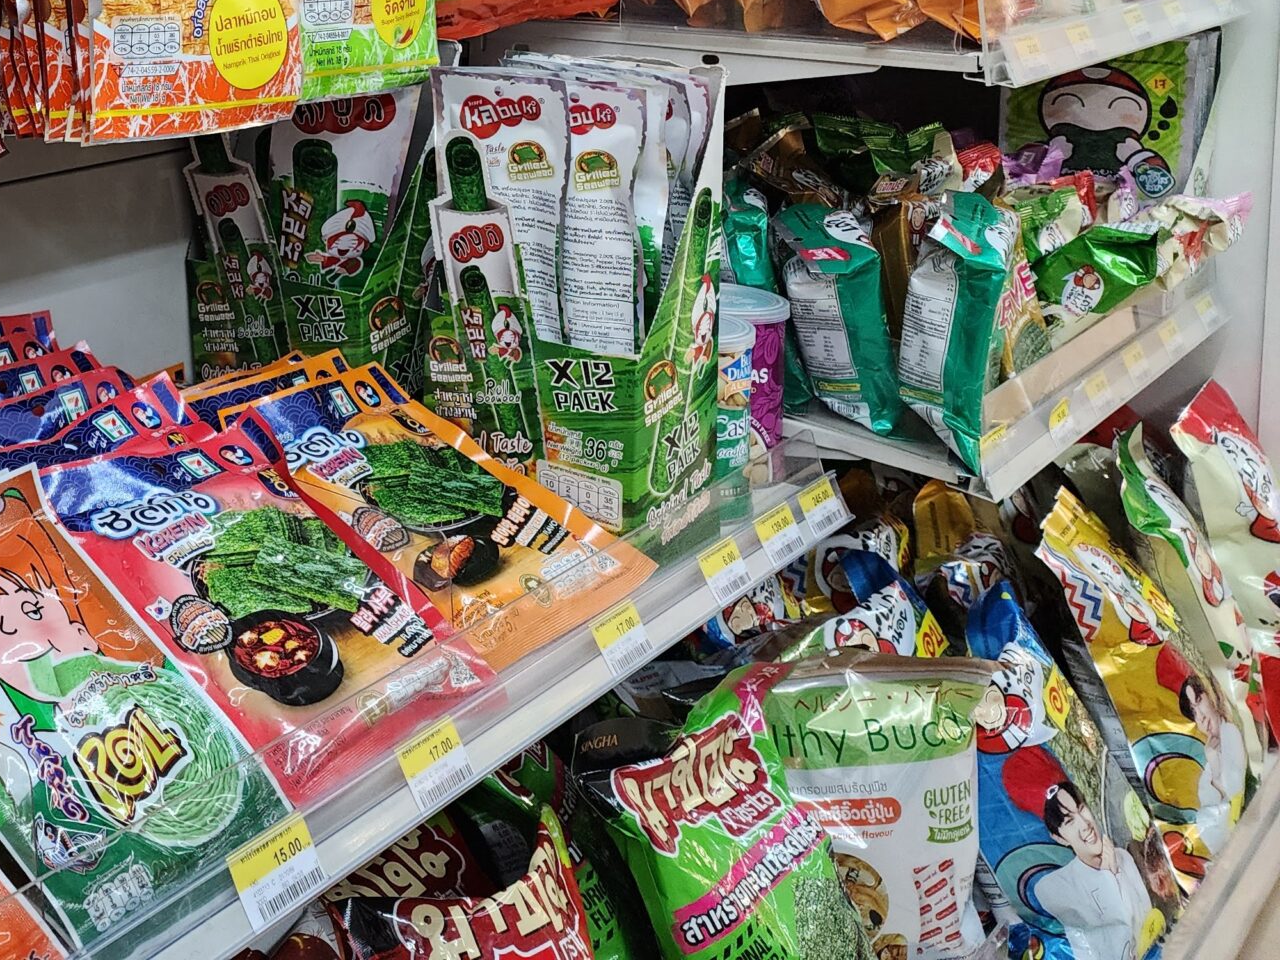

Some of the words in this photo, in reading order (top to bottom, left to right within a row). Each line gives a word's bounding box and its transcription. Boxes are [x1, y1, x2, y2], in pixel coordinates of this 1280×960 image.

[214, 5, 278, 33] ปลาหมึกอบ
[462, 98, 538, 130] Kabuki
[569, 106, 613, 127] buki
[283, 190, 313, 217] Ka
[461, 309, 483, 327] Ka
[299, 321, 349, 343] PACK
[553, 390, 619, 415] PACK
[490, 431, 535, 455] Taste
[584, 438, 608, 462] 36
[666, 438, 702, 482] PACK
[811, 489, 830, 507] 245.00
[135, 512, 209, 558] KOREAN
[166, 534, 215, 567] GRILLED
[721, 550, 736, 566] 6.00
[615, 616, 635, 636] 17.00
[428, 736, 454, 761] 17.00
[579, 734, 620, 755] SINGHA
[772, 724, 846, 764] lthy
[923, 780, 971, 810] GLUTEN
[937, 808, 966, 826] FREE
[861, 827, 895, 841] flavour
[273, 837, 303, 866] 15.00
